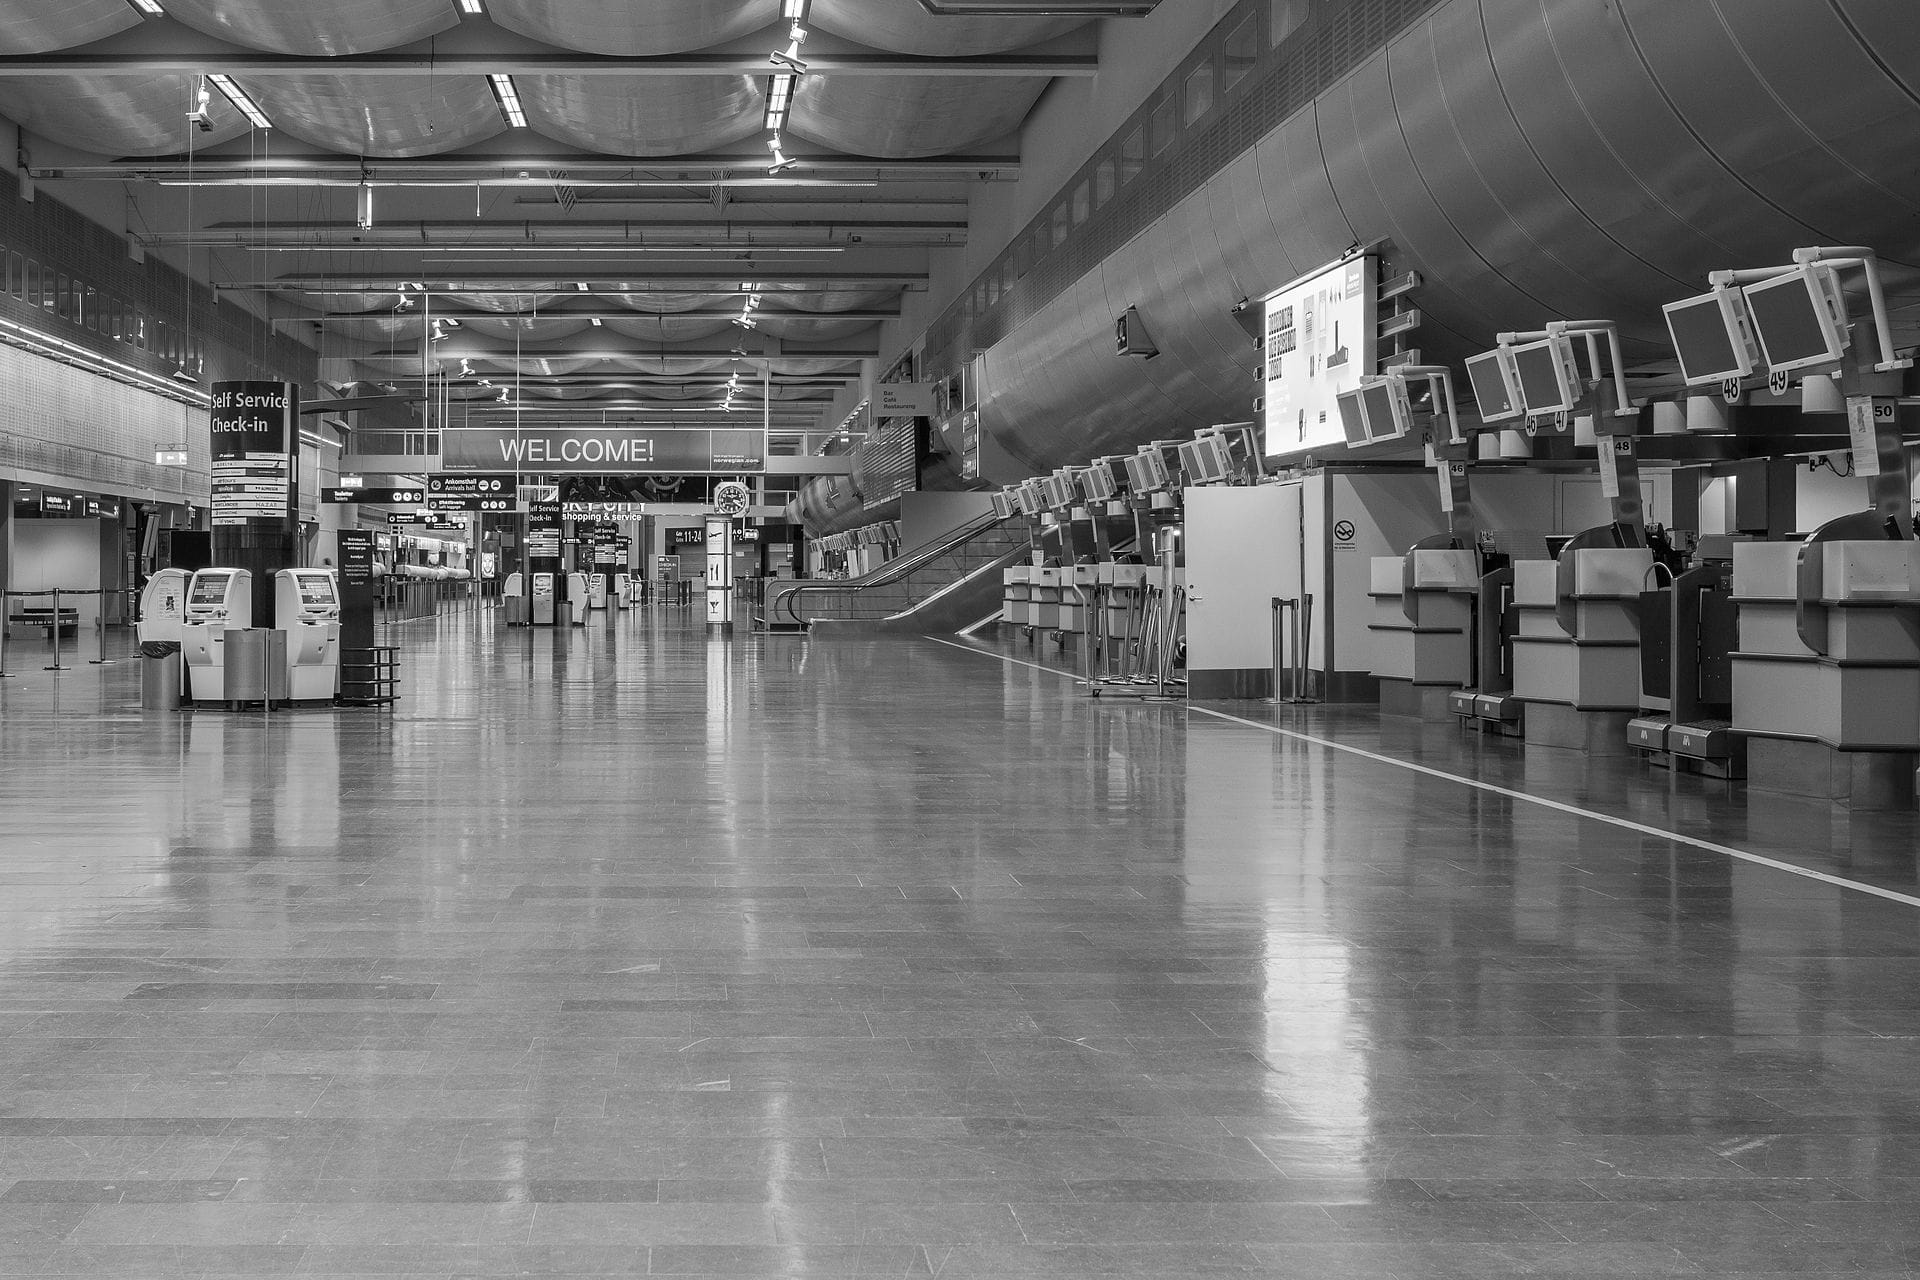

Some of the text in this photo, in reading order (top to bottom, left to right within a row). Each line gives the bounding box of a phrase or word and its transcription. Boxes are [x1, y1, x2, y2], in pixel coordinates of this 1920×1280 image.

[1724, 377, 1739, 399] 48
[1771, 370, 1786, 391] 49
[212, 391, 289, 409] Self Service
[1874, 405, 1893, 417] 50
[212, 415, 268, 433] Check-in
[1526, 415, 1536, 433] 46
[499, 438, 654, 462] WELCOME!
[1615, 441, 1630, 451] 48
[1451, 464, 1464, 473] 46
[562, 512, 642, 523] shopping & service
